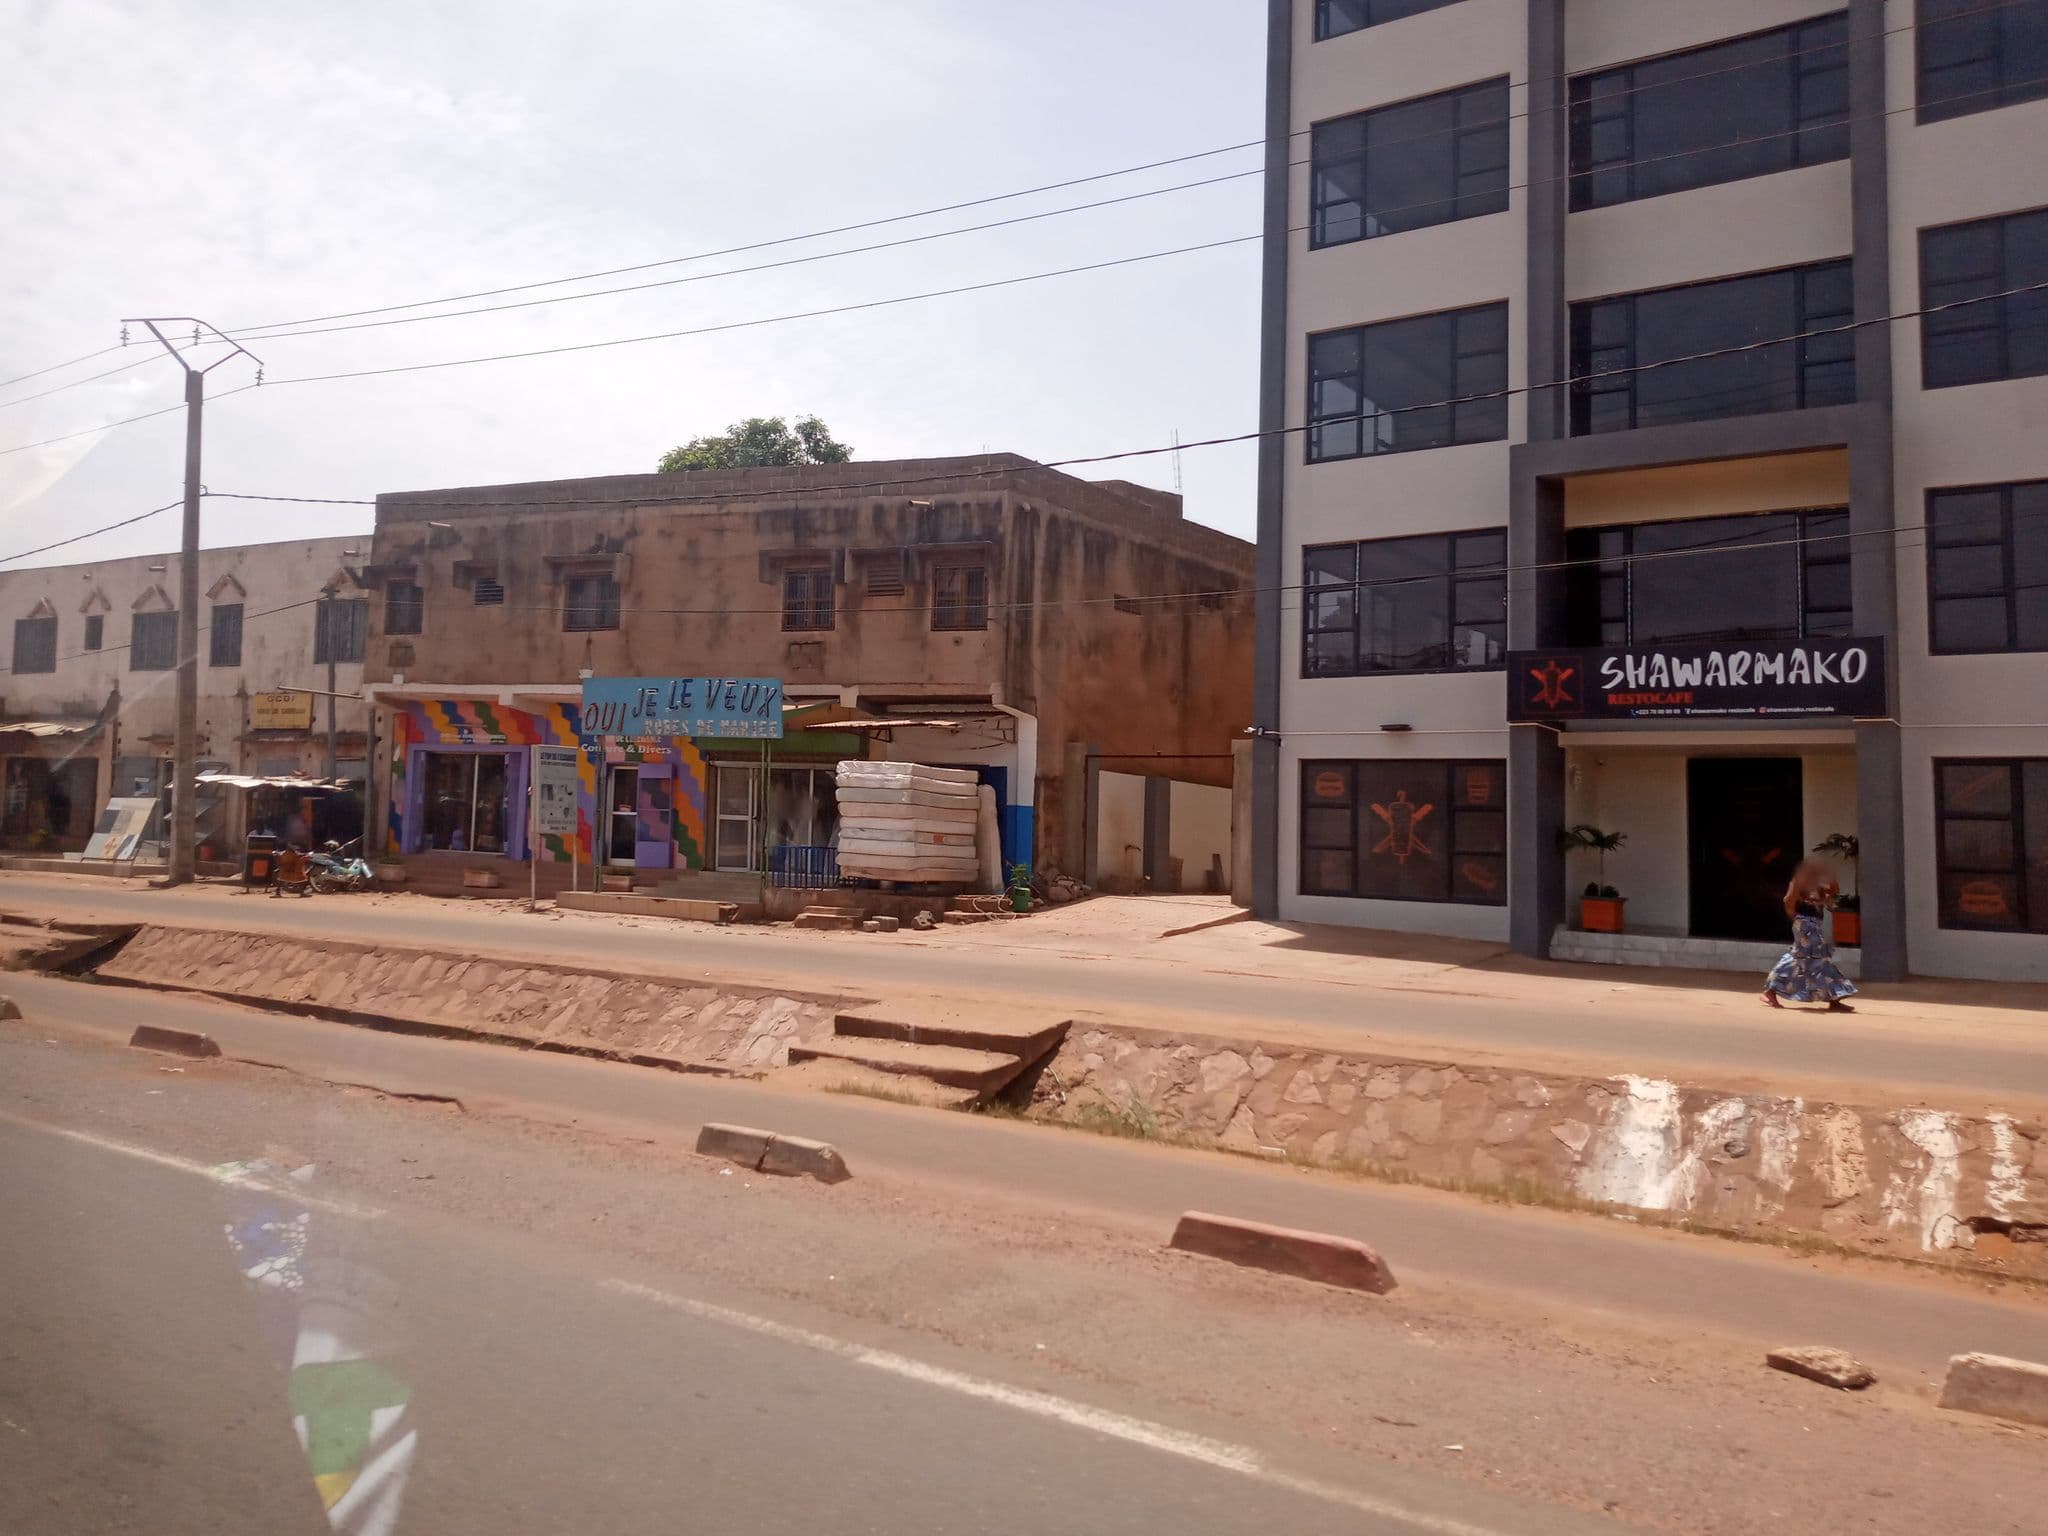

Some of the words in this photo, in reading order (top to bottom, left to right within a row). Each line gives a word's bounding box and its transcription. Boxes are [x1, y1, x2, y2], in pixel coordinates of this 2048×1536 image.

[1600, 647, 1868, 689] SHAWARMAKO
[584, 702, 627, 732] OUI
[631, 687, 659, 718] JE
[667, 678, 693, 712] LE
[705, 678, 777, 719] VEUX
[626, 743, 636, 753] &
[638, 744, 672, 754] Divers
